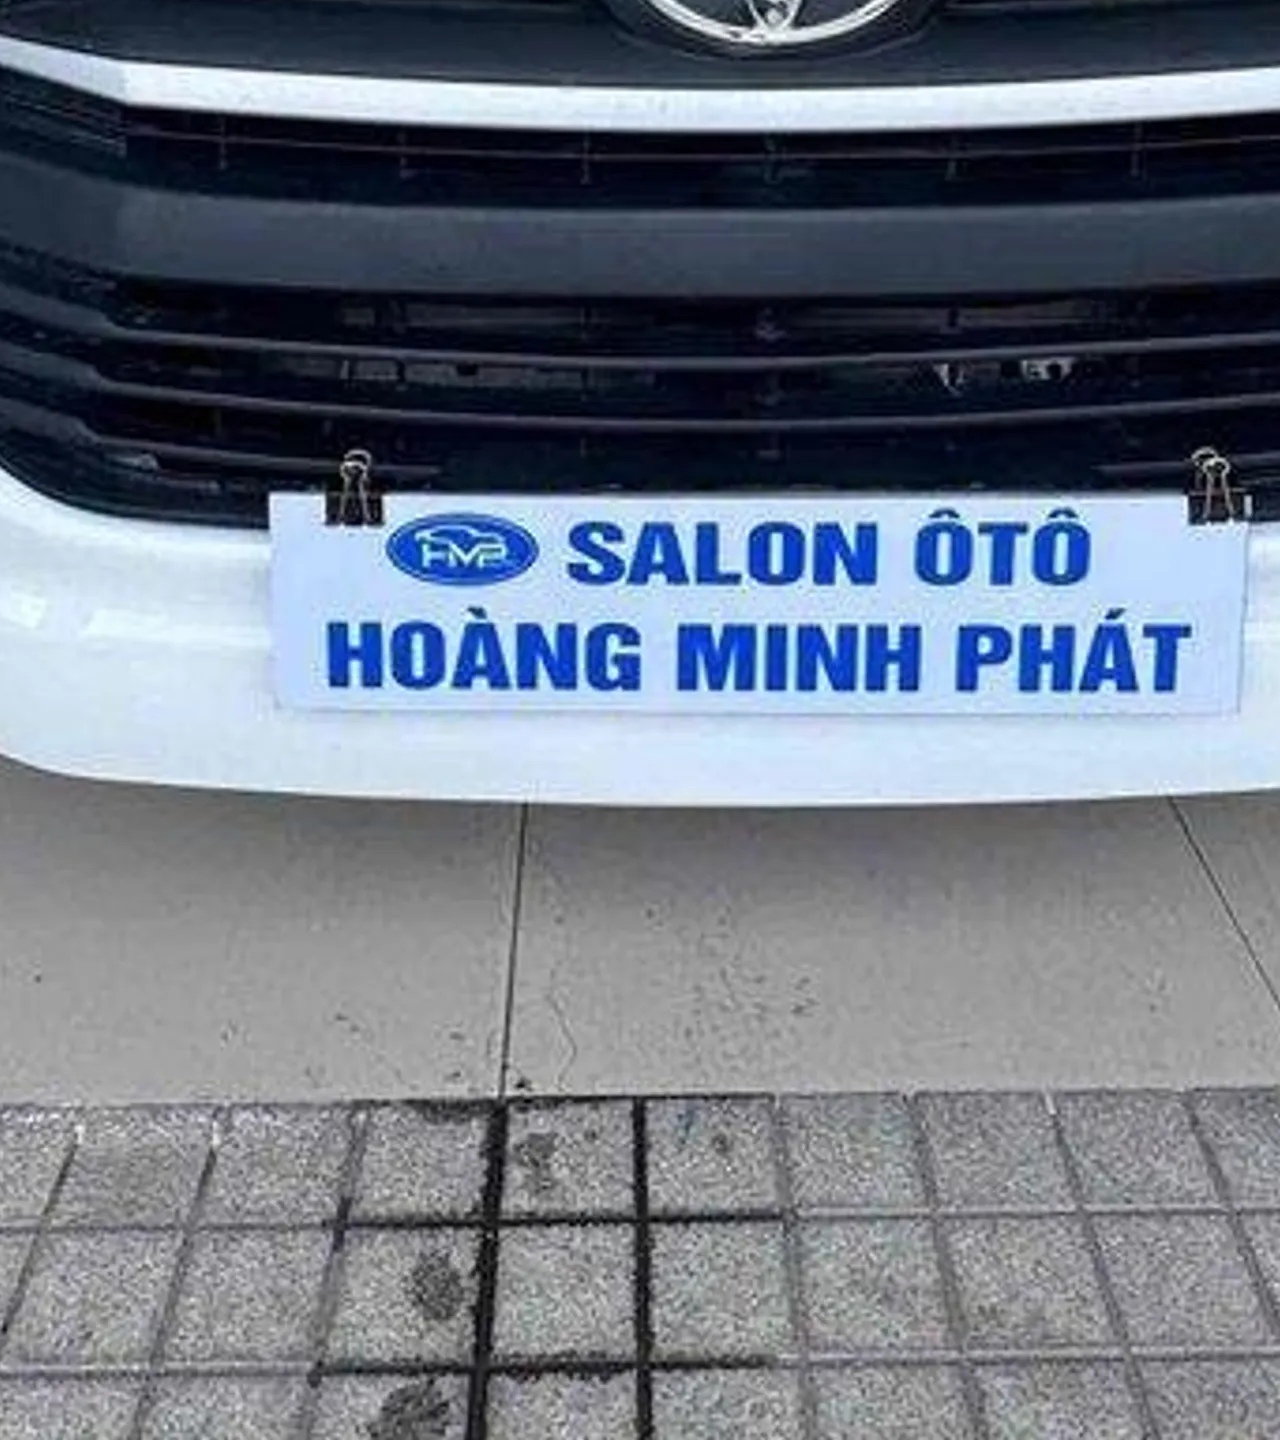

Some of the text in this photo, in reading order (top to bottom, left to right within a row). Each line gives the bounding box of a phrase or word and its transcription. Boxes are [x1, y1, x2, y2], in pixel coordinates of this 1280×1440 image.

[567, 520, 878, 587] SALON
[913, 507, 1092, 587] ÔTÔ
[325, 606, 1193, 694] HOÀNG MINH PHÁT
